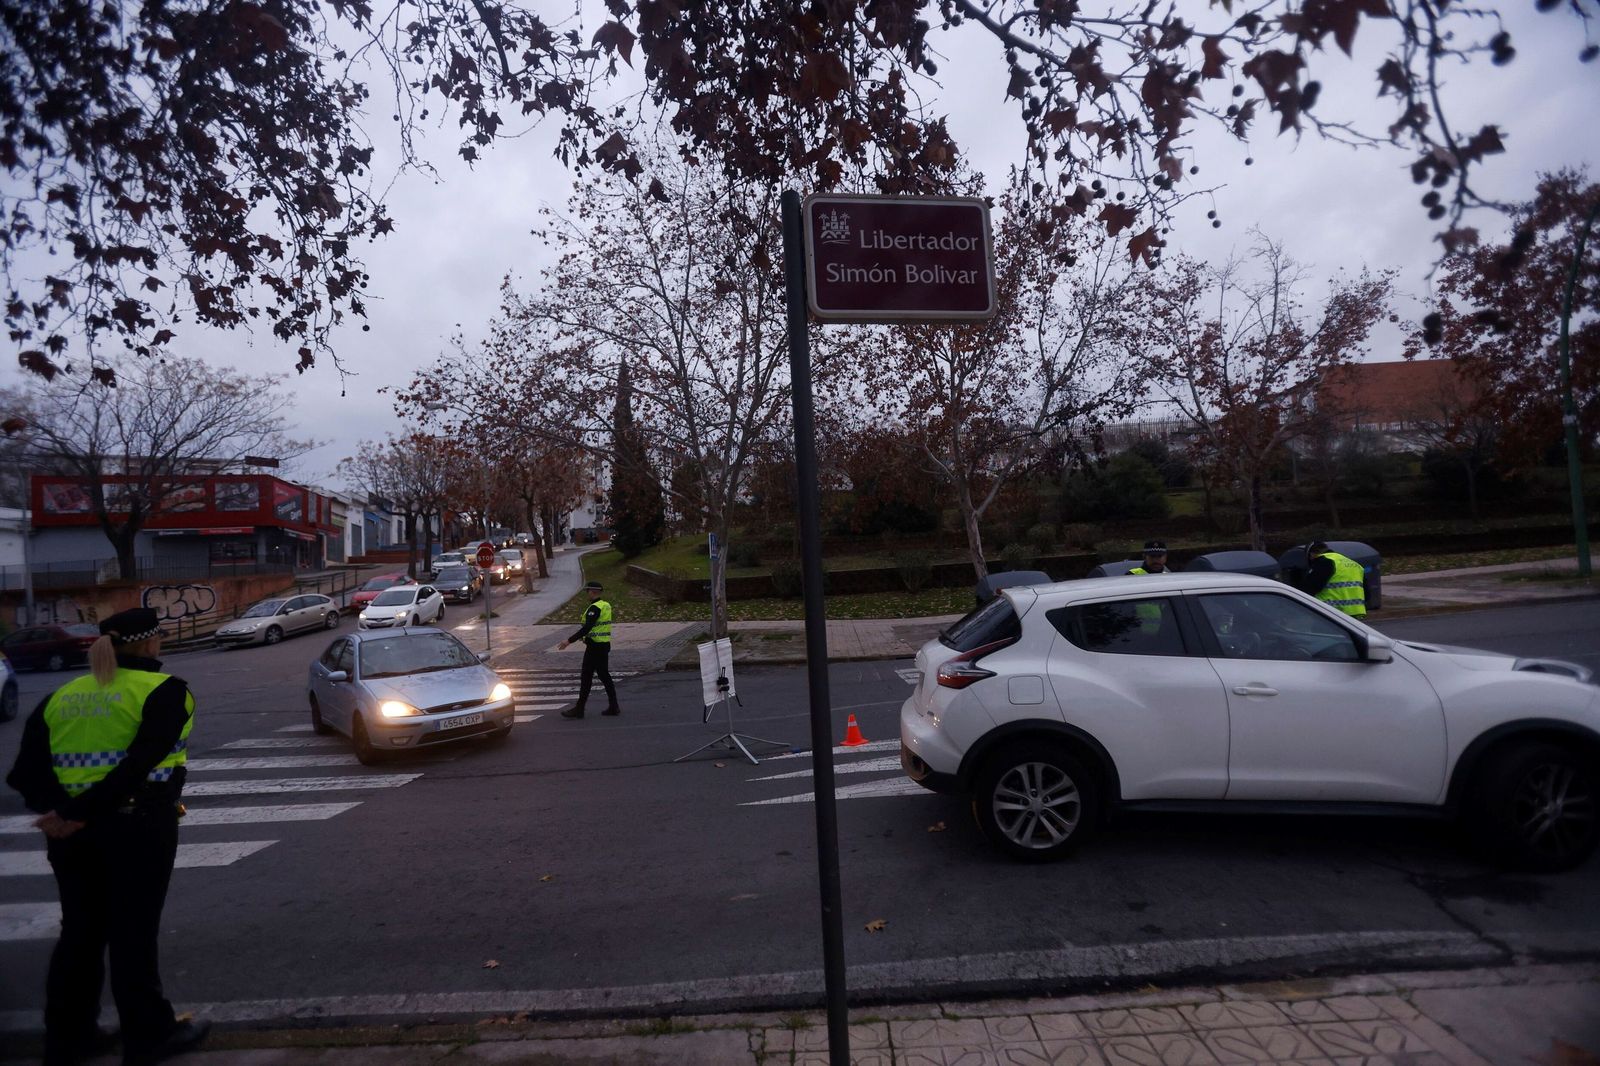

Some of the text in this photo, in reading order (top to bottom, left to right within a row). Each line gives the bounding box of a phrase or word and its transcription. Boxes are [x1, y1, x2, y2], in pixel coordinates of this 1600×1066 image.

[859, 229, 979, 251] Libertador
[826, 262, 978, 285] Simón Bolivar
[477, 553, 494, 562] STOP
[61, 706, 112, 719] LOCAL
